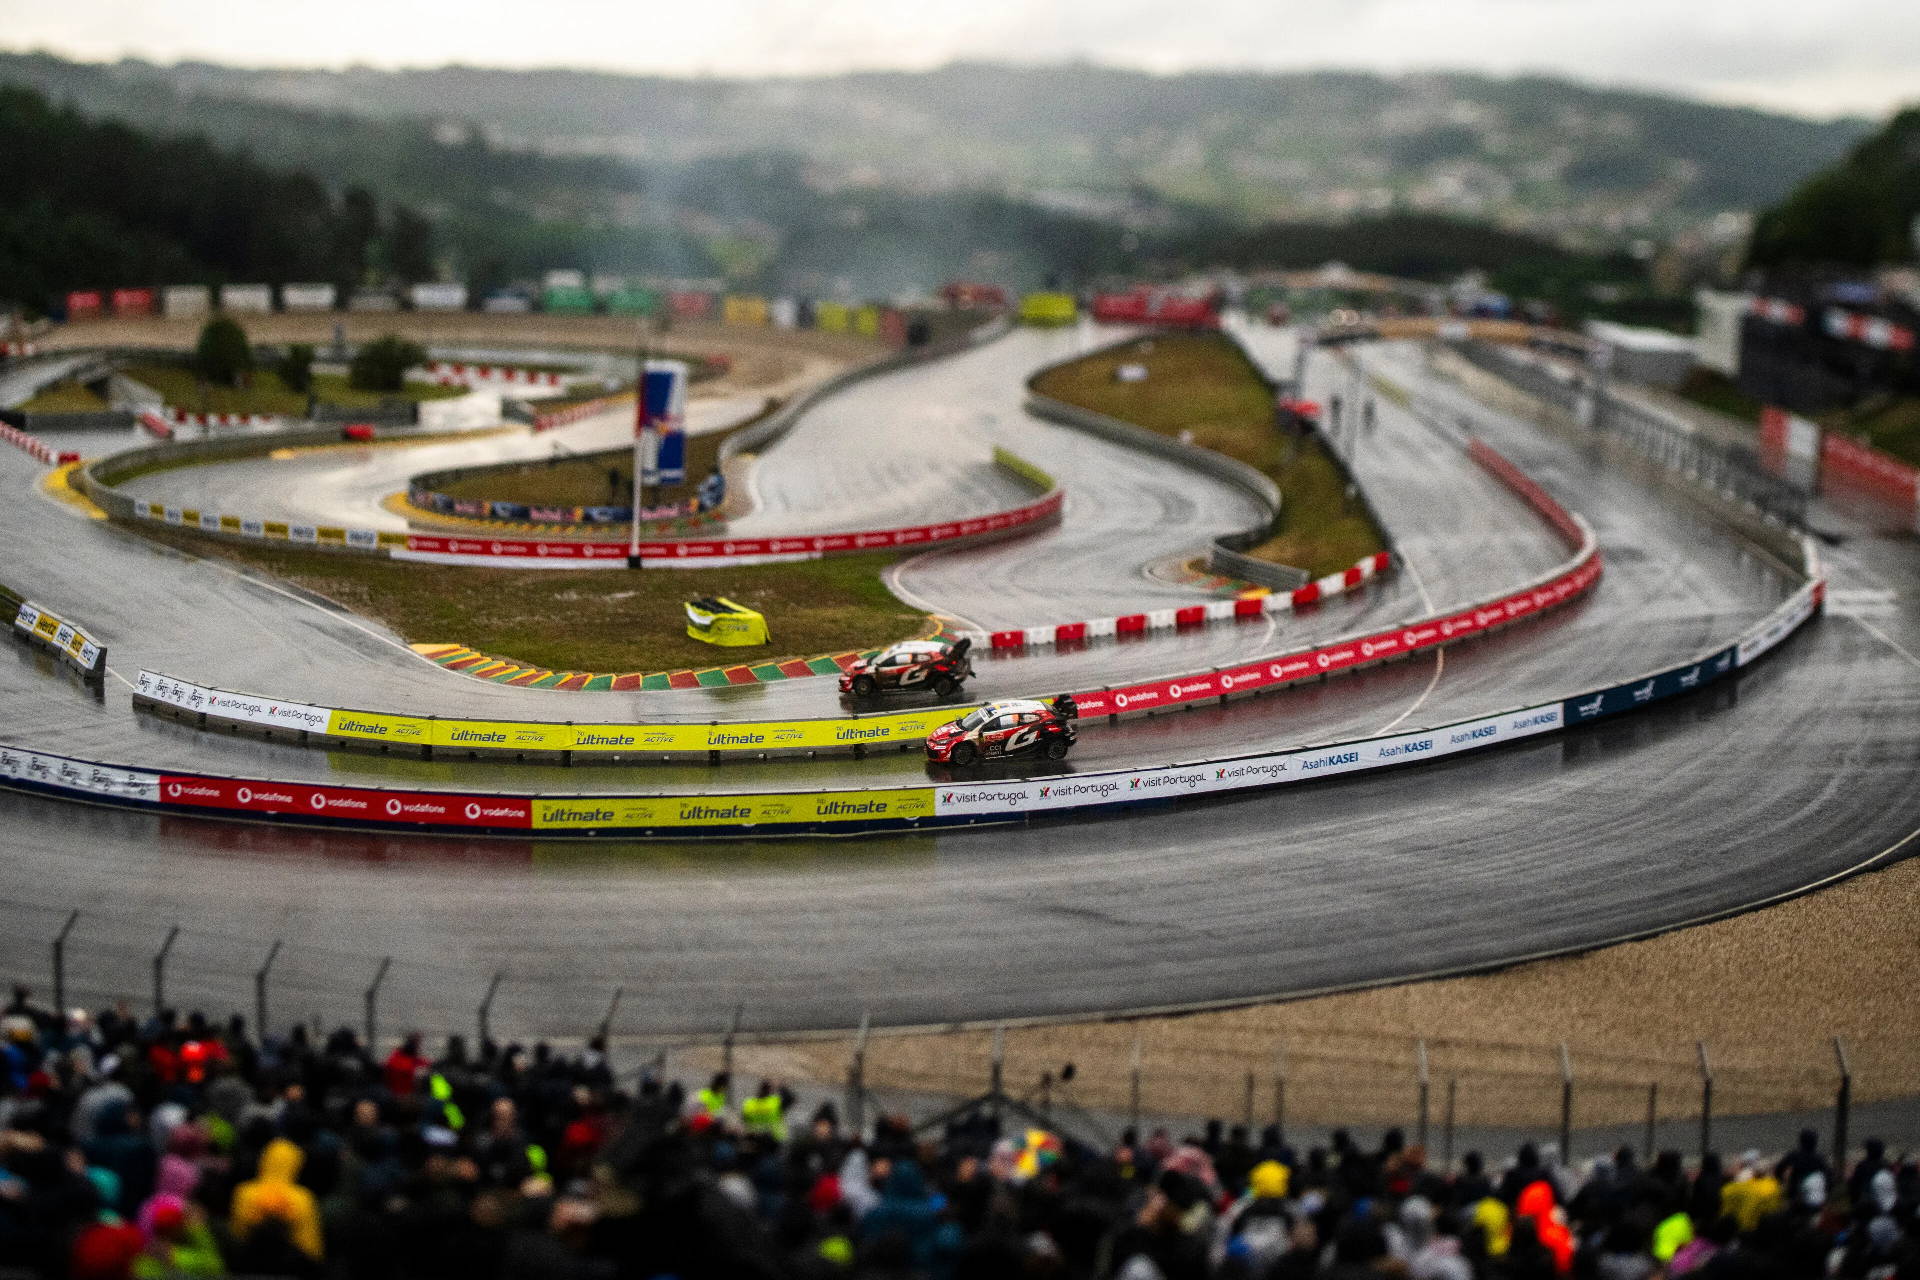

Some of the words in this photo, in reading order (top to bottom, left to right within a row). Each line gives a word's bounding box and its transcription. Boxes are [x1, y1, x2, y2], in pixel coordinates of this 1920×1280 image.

[1077, 700, 1104, 710] odafone
[338, 721, 388, 735] ultimate
[836, 726, 890, 740] ultimate
[450, 730, 506, 742] ultimate
[576, 733, 634, 745] ultimate
[707, 732, 764, 745] ultimate
[1378, 740, 1433, 758] AsahiKASEI
[1302, 752, 1359, 770] AsahiKASEI
[183, 787, 220, 797] vodafone
[254, 793, 293, 803] vodafone
[328, 798, 368, 809] vodafone
[403, 803, 445, 814] vodafone
[817, 800, 888, 815] ultimate
[482, 807, 526, 818] vodafone
[543, 808, 614, 822] ultimate
[680, 805, 751, 820] ultimate
